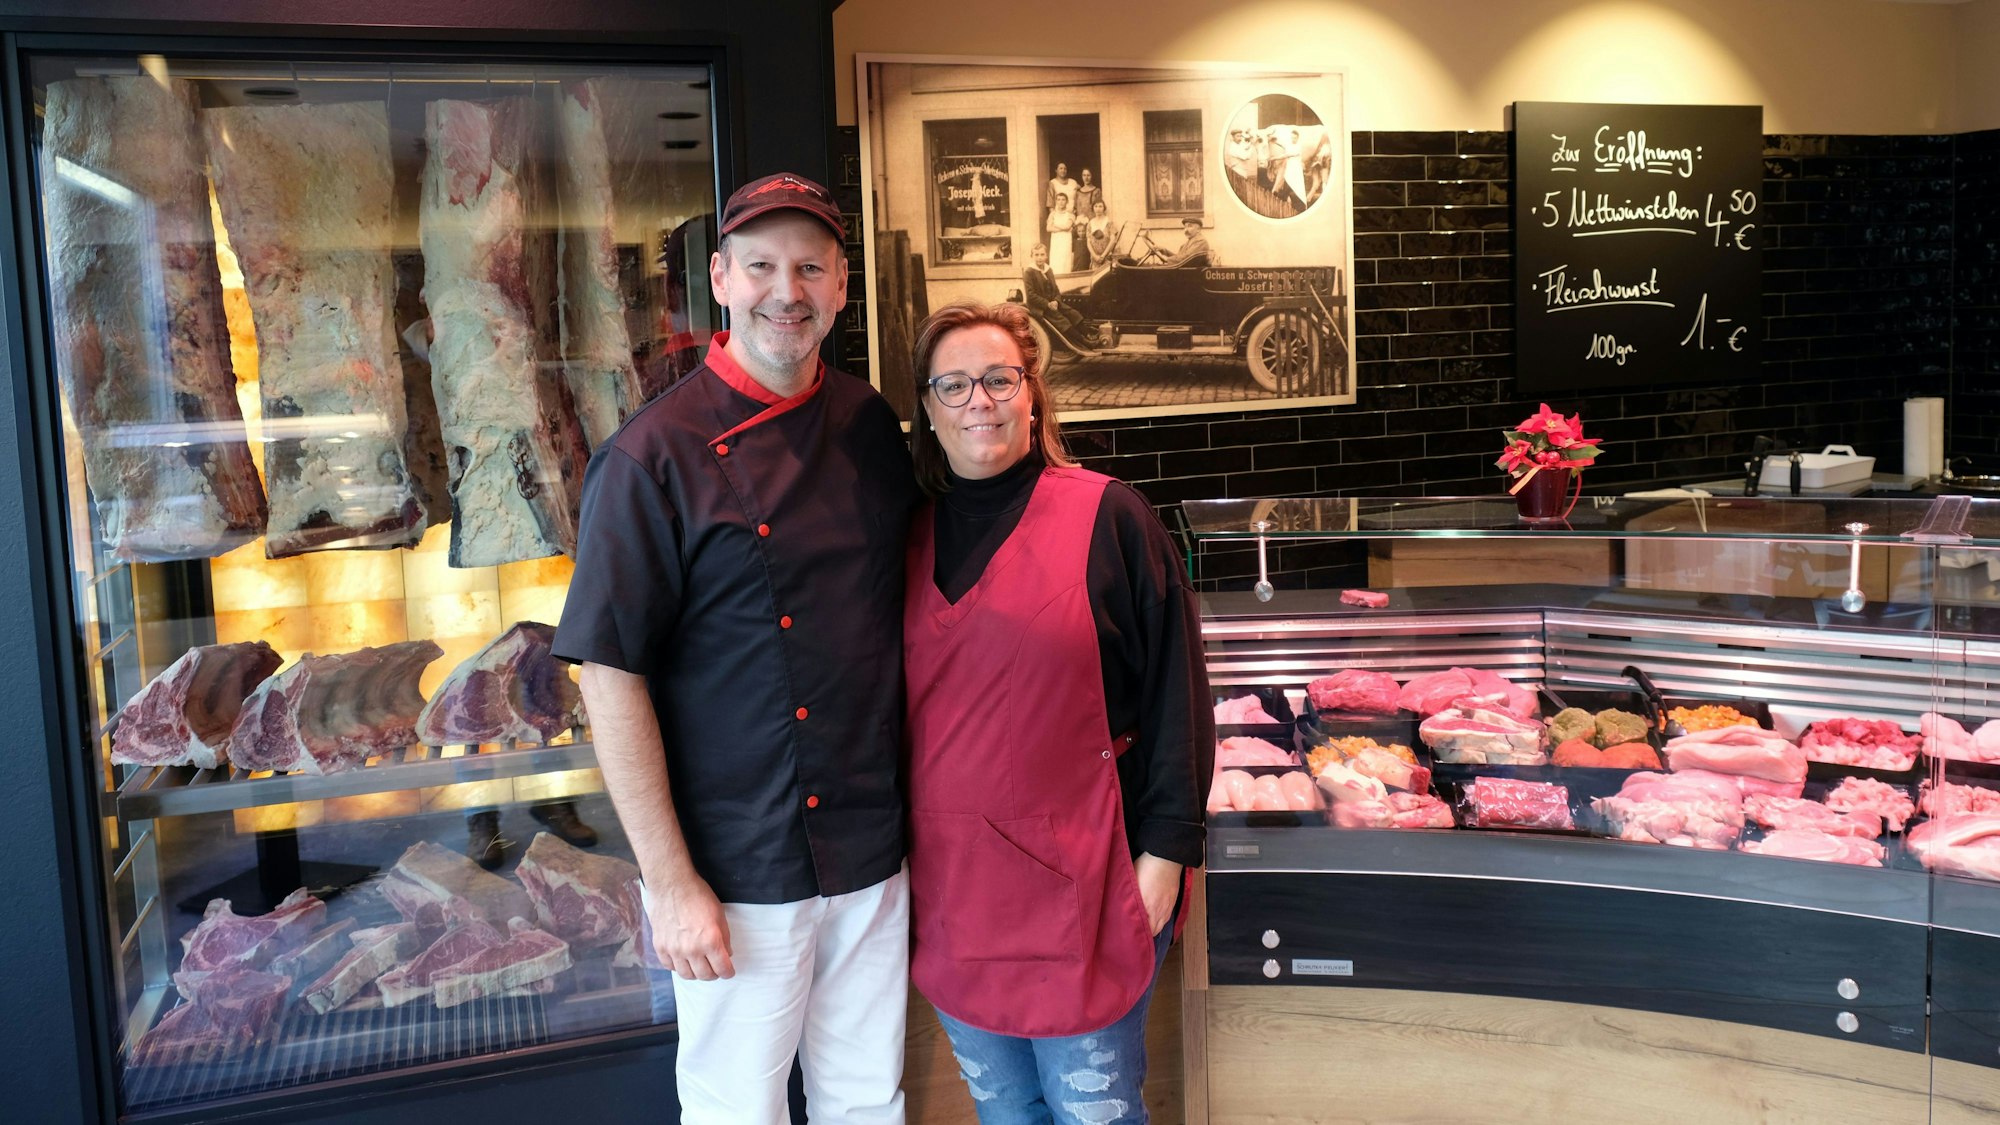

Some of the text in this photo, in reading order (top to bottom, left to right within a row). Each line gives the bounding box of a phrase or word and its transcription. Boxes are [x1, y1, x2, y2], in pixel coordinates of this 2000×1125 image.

[1551, 125, 1703, 178] Zur Eröffnung:
[1542, 191, 1561, 227] 5
[1205, 270, 1236, 280] Ochsen
[1238, 281, 1267, 292] Josef
[1538, 264, 1660, 306] Fleischwurst
